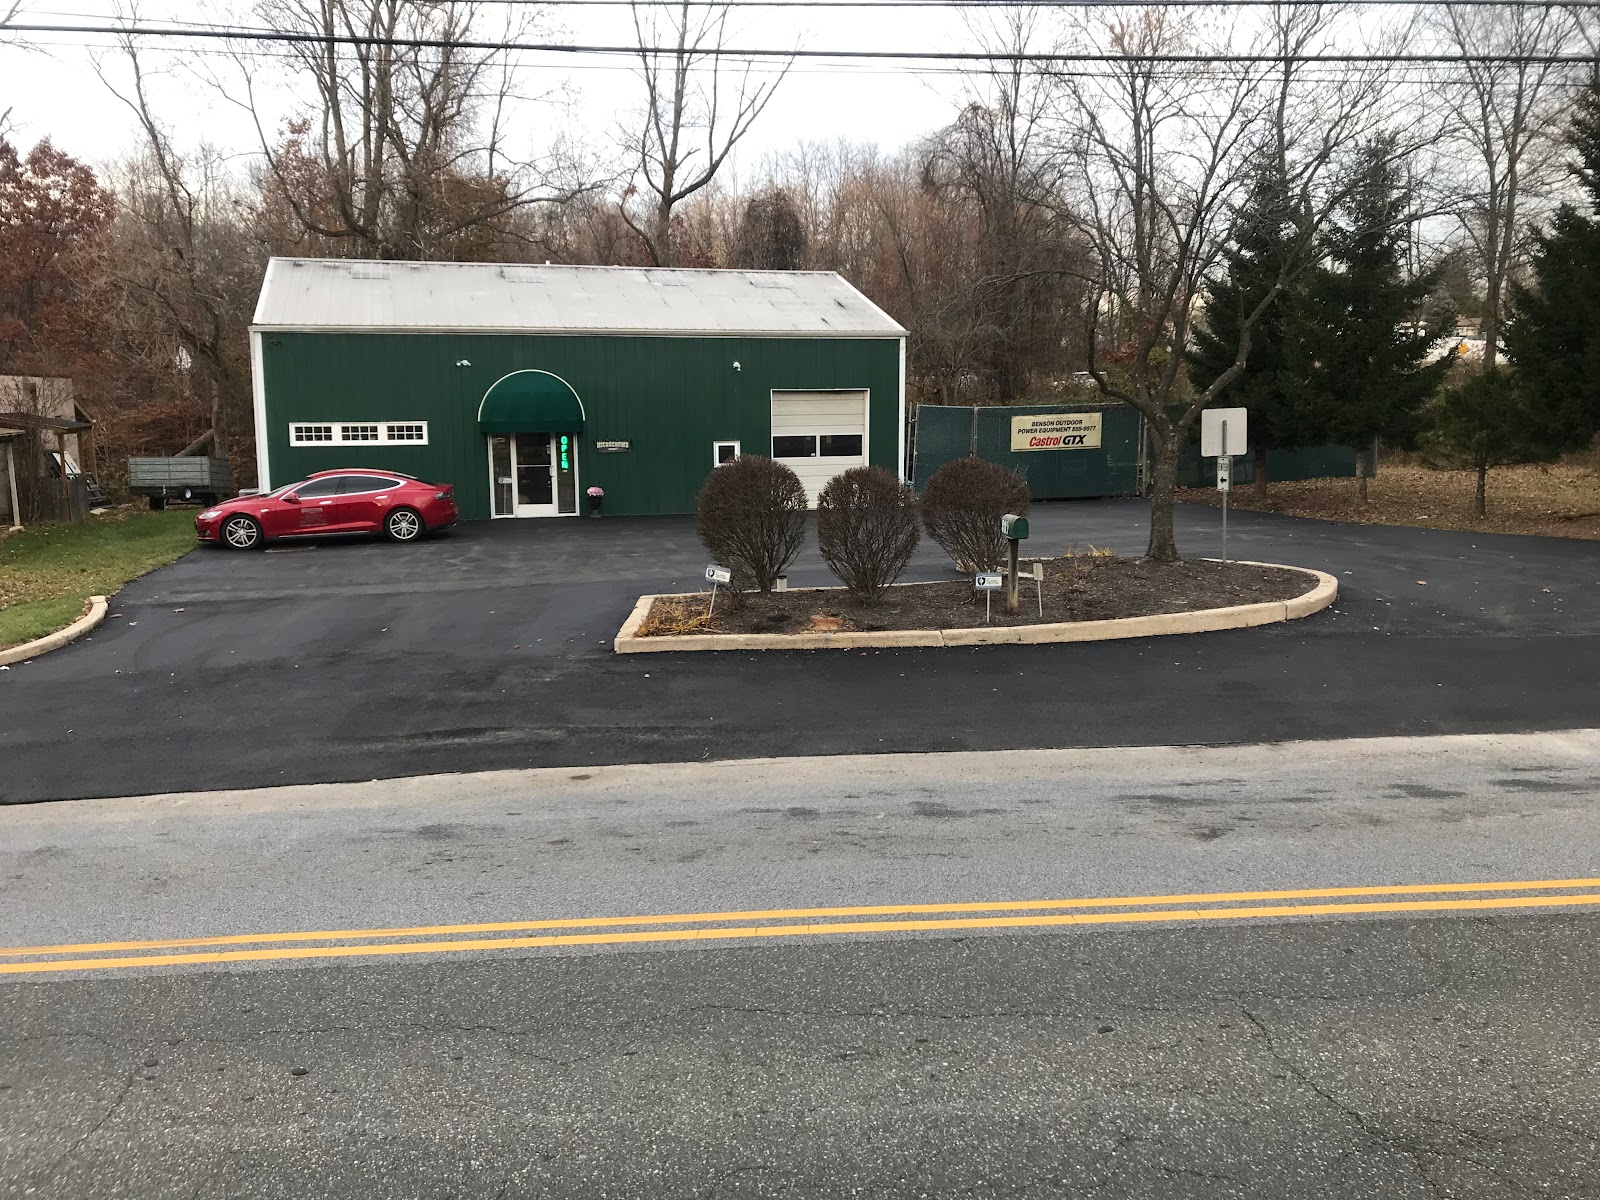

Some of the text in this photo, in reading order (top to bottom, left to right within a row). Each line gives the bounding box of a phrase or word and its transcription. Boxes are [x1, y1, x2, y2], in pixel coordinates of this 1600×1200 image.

[1039, 426, 1071, 434] EQUIPMENT
[1029, 434, 1087, 447] Castrol GTX
[560, 435, 569, 469] OPEN
